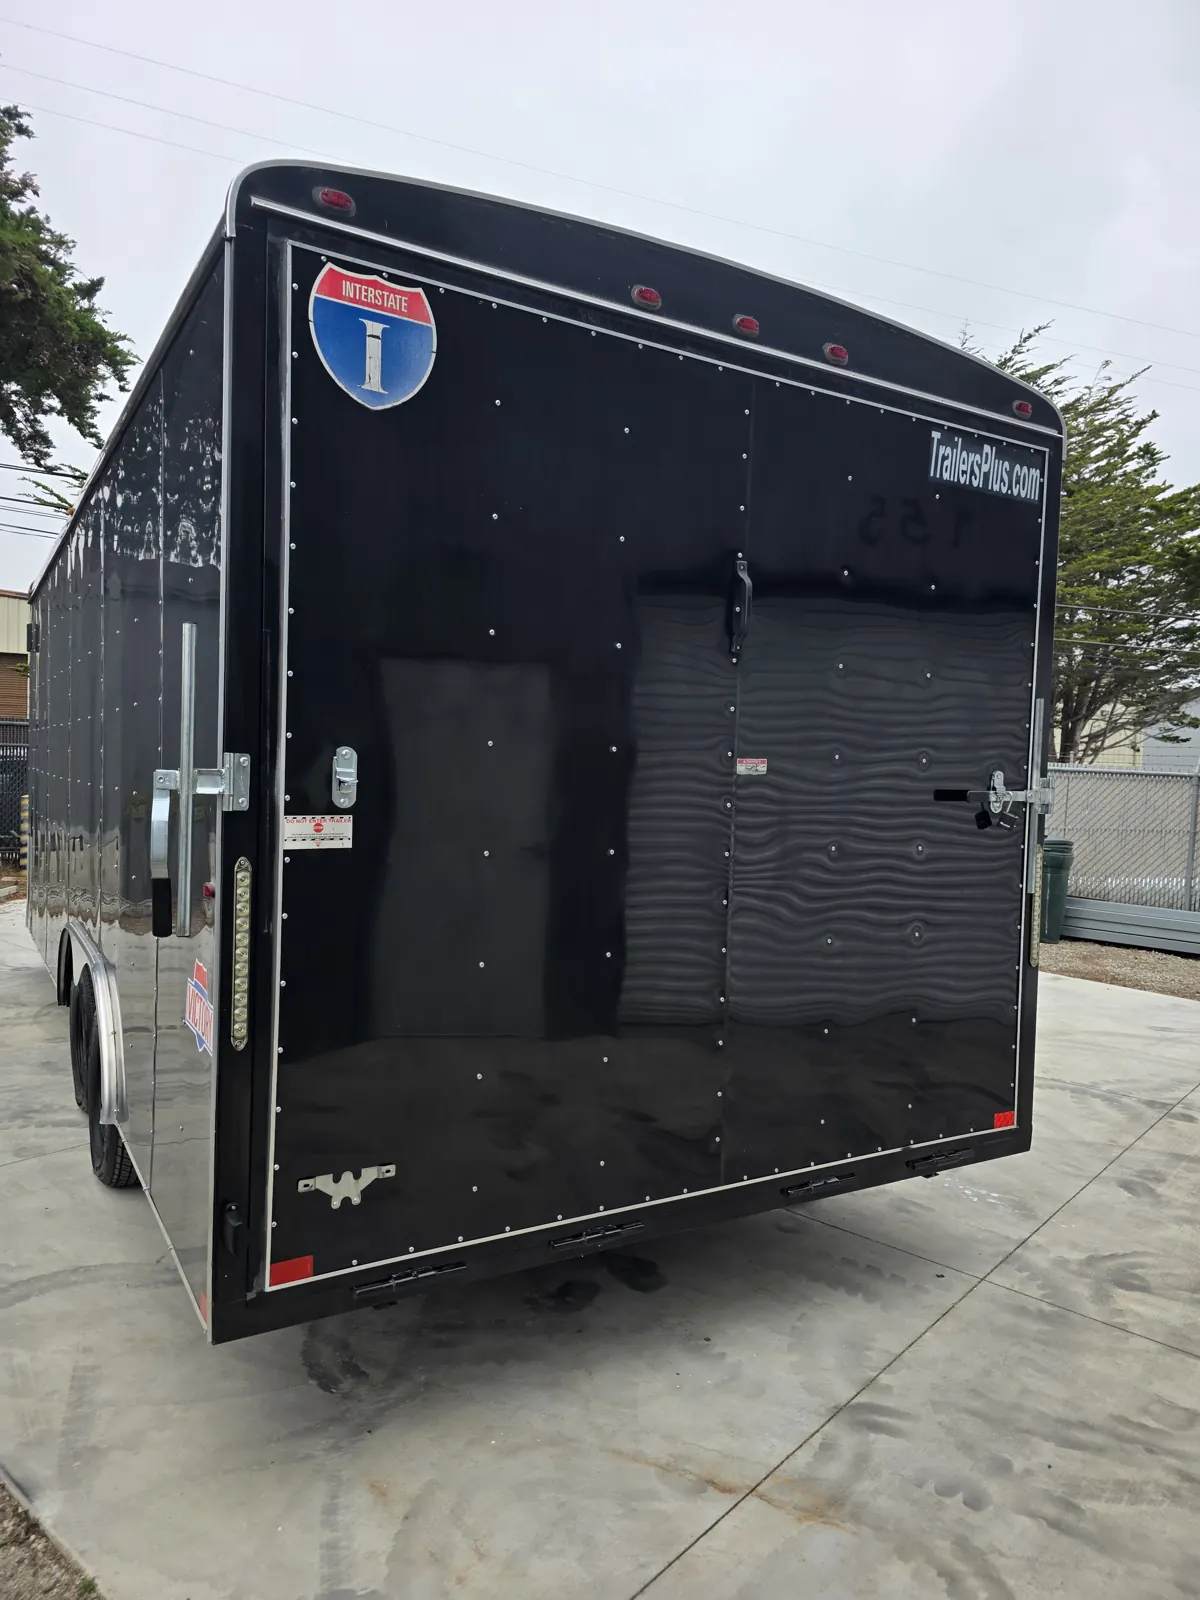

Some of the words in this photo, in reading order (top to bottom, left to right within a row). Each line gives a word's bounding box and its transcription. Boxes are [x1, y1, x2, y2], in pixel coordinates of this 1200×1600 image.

[342, 279, 408, 313] INTERSTATE
[358, 317, 390, 395] I
[930, 430, 1040, 501] TrailersPlus.com
[187, 983, 213, 1050] VICTORY
